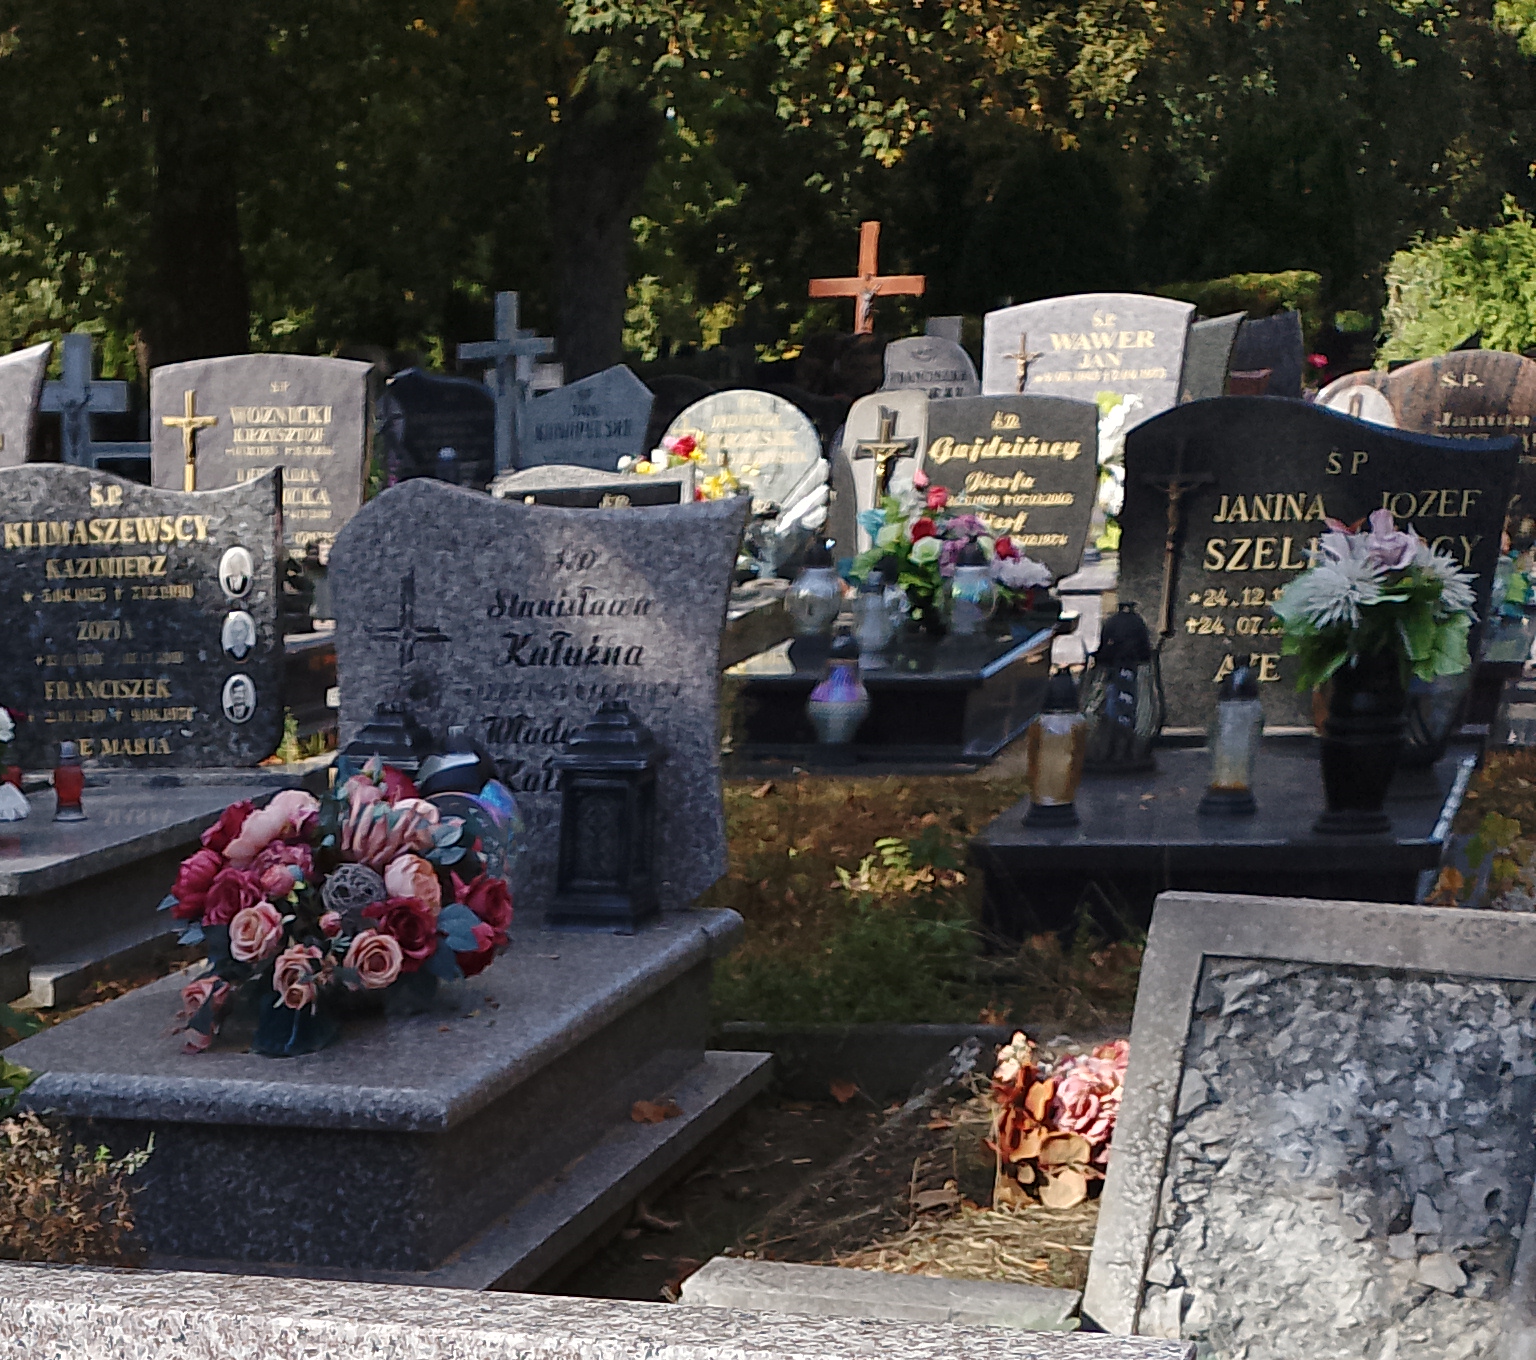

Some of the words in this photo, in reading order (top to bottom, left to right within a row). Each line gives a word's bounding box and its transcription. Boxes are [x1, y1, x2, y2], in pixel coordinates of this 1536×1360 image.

[1050, 330, 1157, 351] WAWER
[1077, 352, 1124, 369] JAN
[1213, 493, 1328, 523] JANINA
[4, 514, 213, 549] KLIMASZEWSCY
[45, 555, 168, 581] KAZIMIERZ
[44, 678, 173, 701] FRANCISZEK
[99, 736, 173, 757] MARIA
